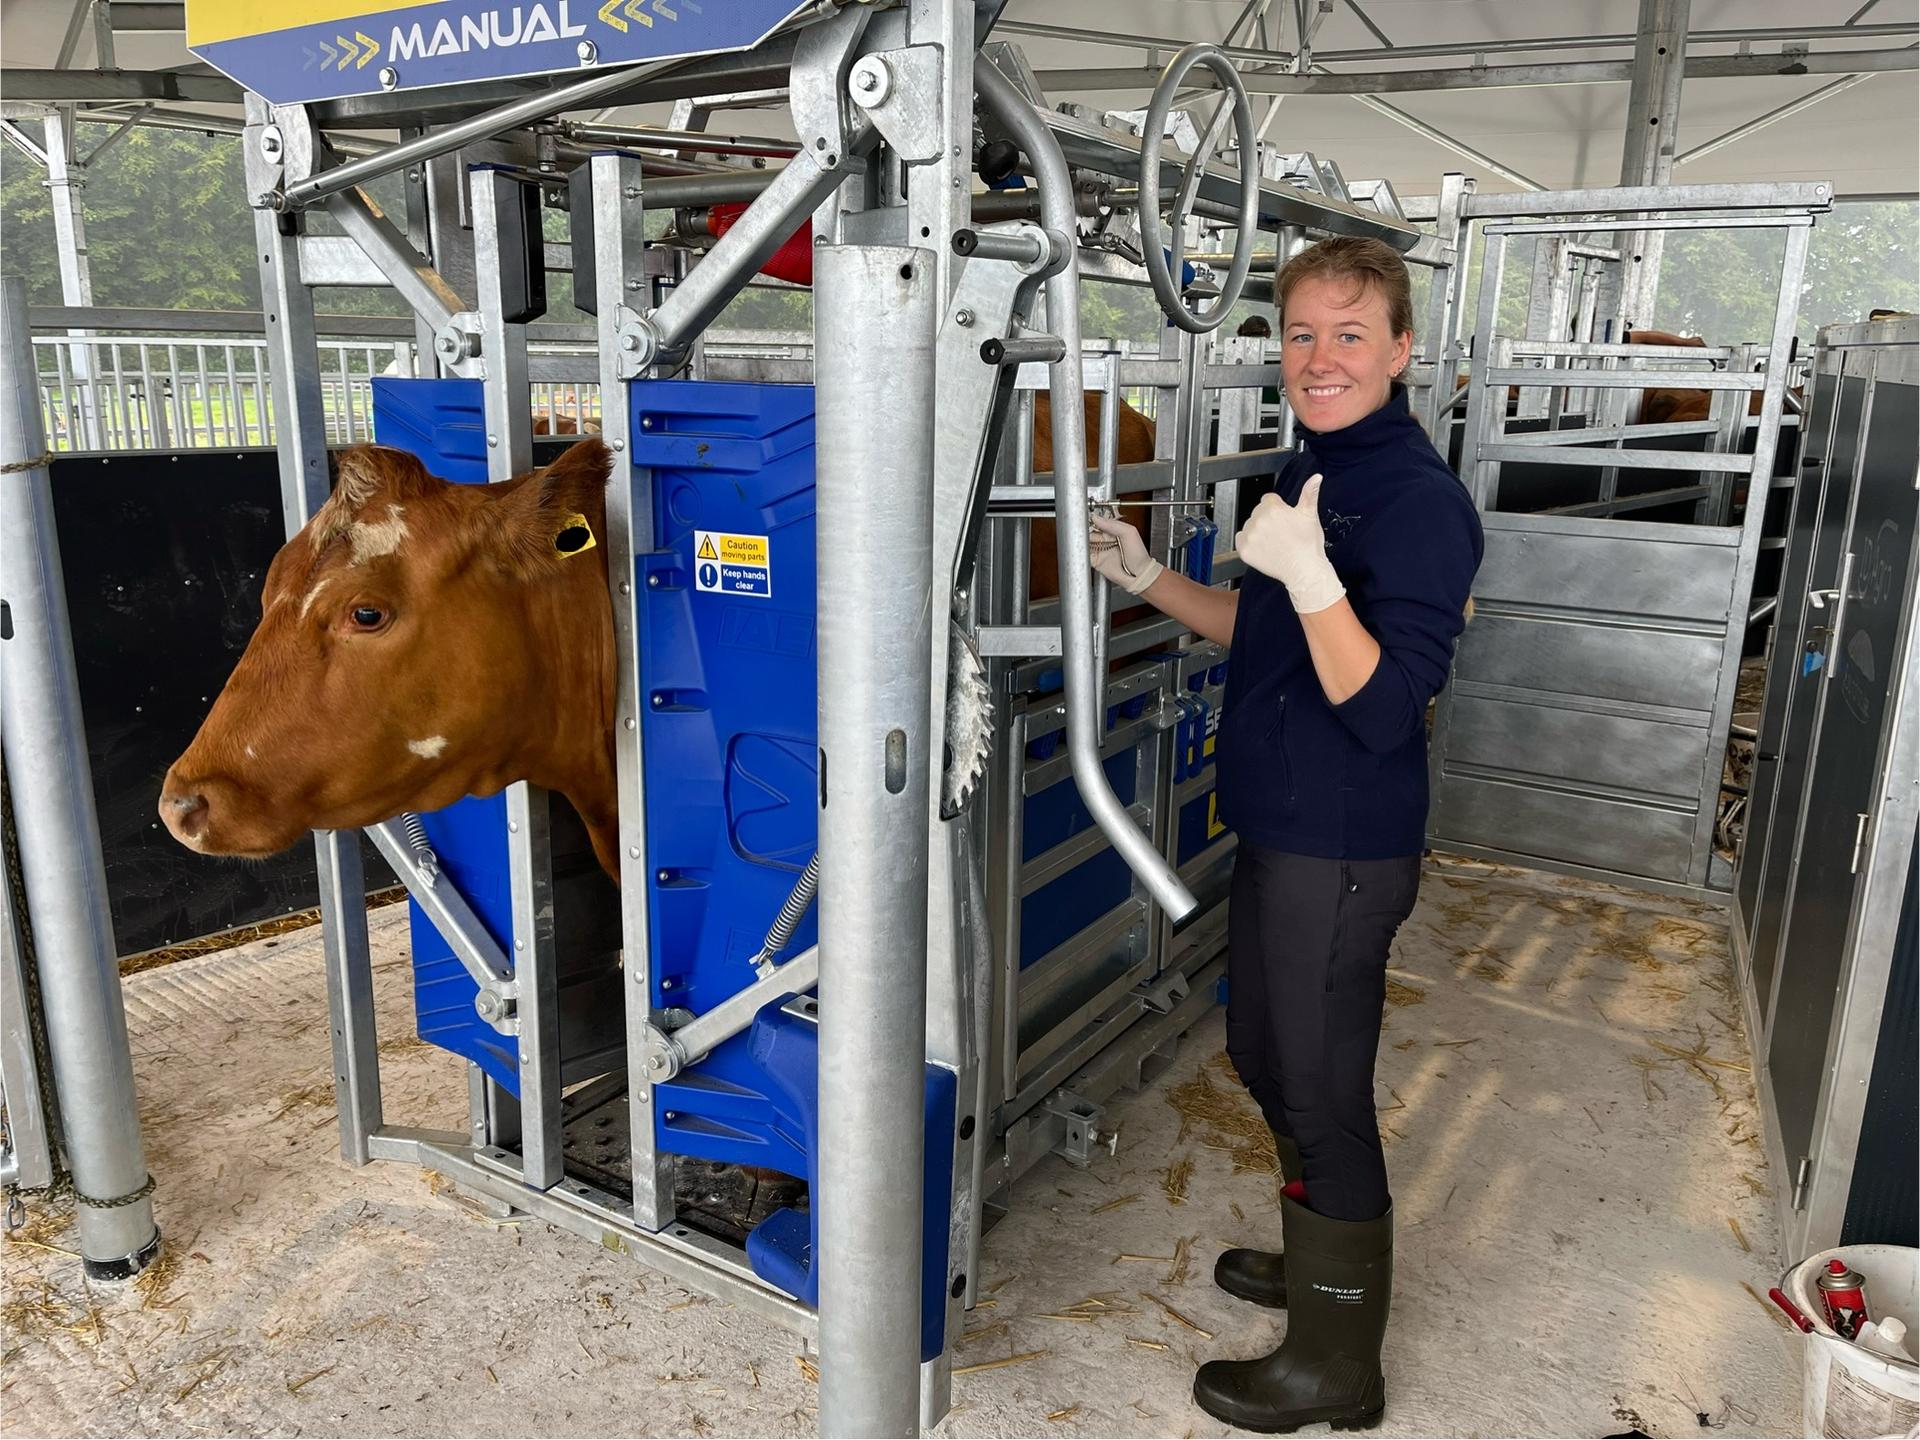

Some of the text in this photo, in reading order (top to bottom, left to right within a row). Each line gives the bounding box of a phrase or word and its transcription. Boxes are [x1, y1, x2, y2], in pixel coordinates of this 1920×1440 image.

[388, 0, 587, 62] MANUAL
[727, 540, 758, 551] Caution
[721, 551, 765, 562] moving parts
[723, 568, 766, 580] Keep hands
[735, 581, 754, 590] clear
[1320, 1286, 1364, 1294] DUNLOP
